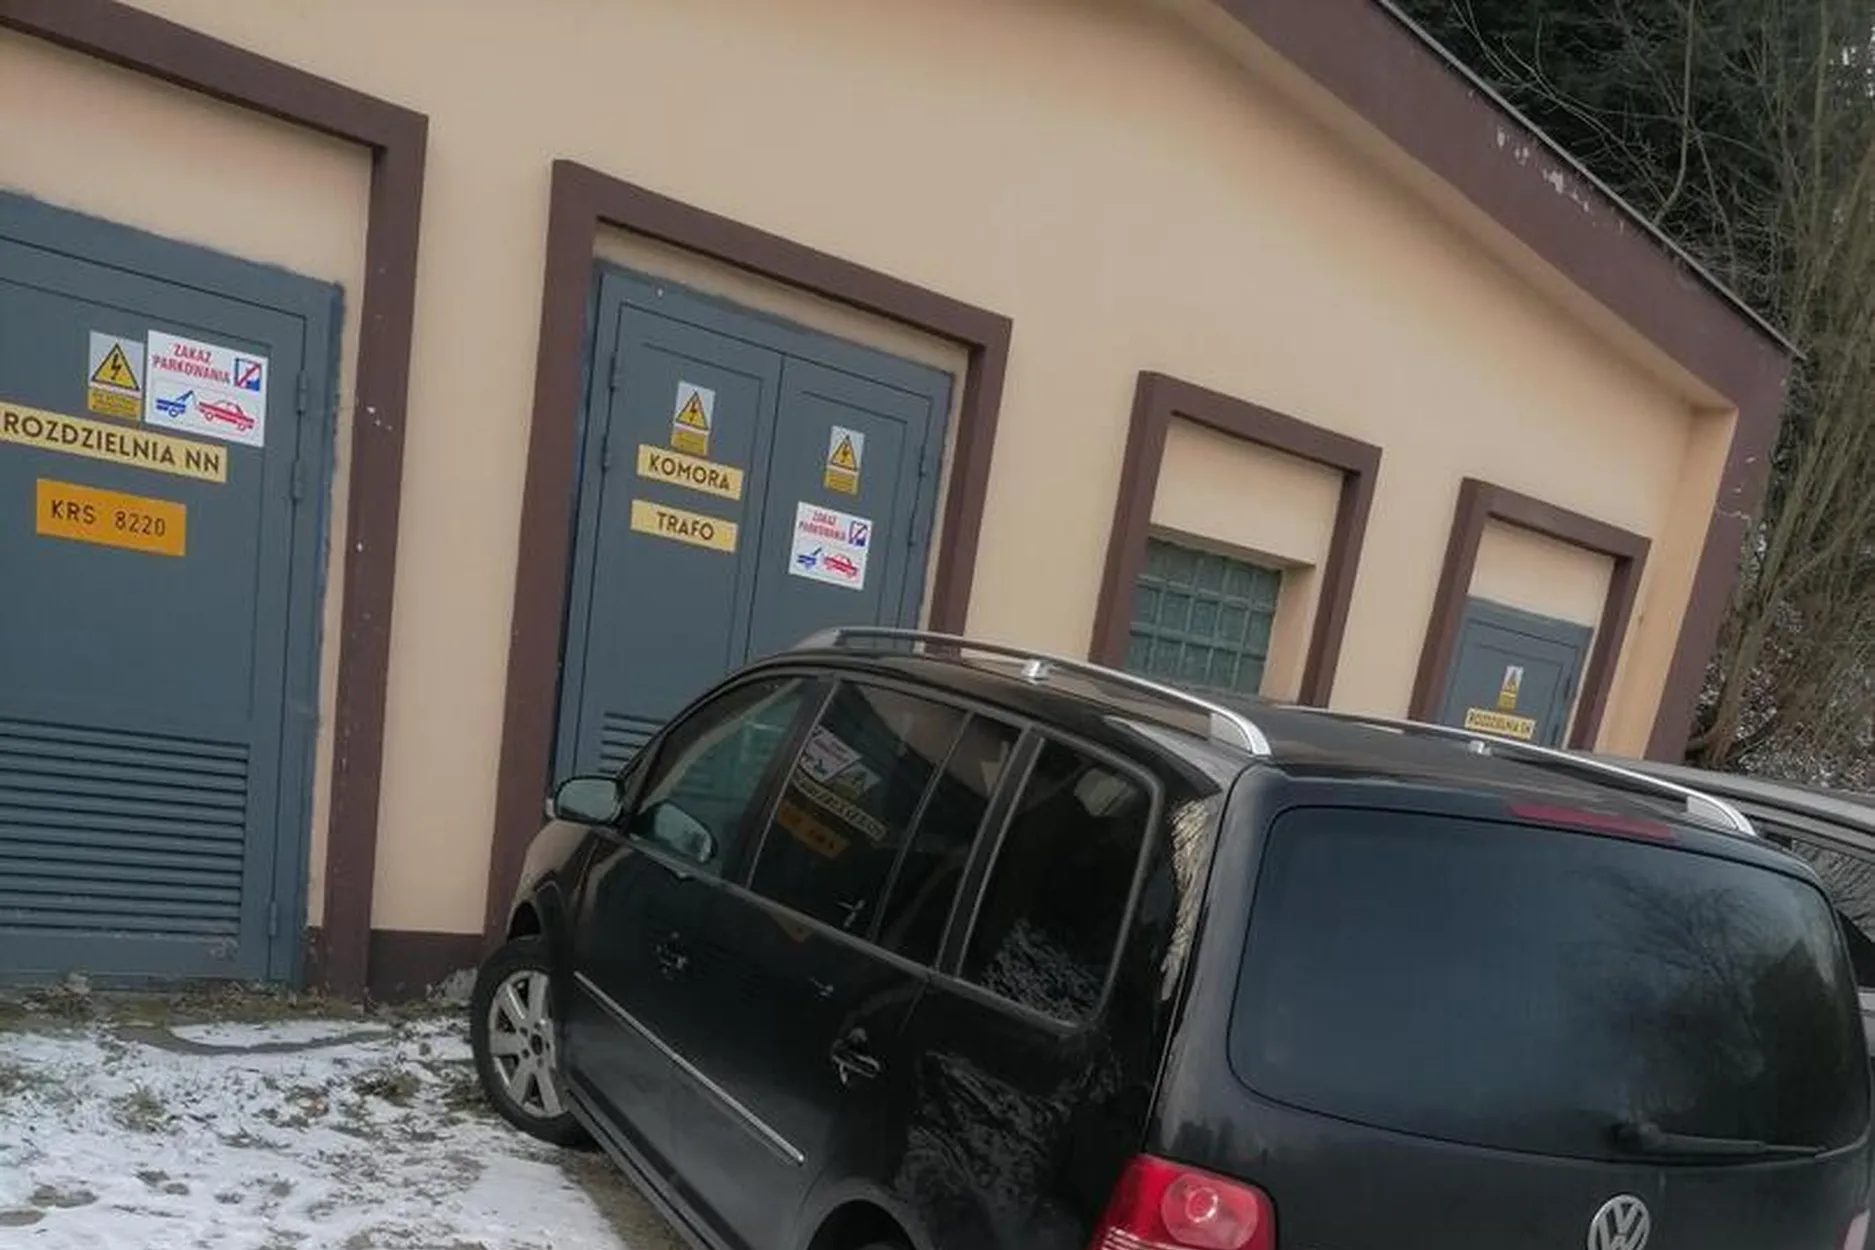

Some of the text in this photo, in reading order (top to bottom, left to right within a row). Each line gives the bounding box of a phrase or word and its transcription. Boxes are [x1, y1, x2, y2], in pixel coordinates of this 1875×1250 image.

[152, 355, 231, 384] PARKOWANIA
[174, 343, 211, 364] ZAKAZ
[3, 411, 220, 474] ROZDZIELNIA NN
[649, 454, 730, 491] KOMORA
[51, 499, 166, 537] KRS 8220
[657, 511, 714, 541] TRAFO
